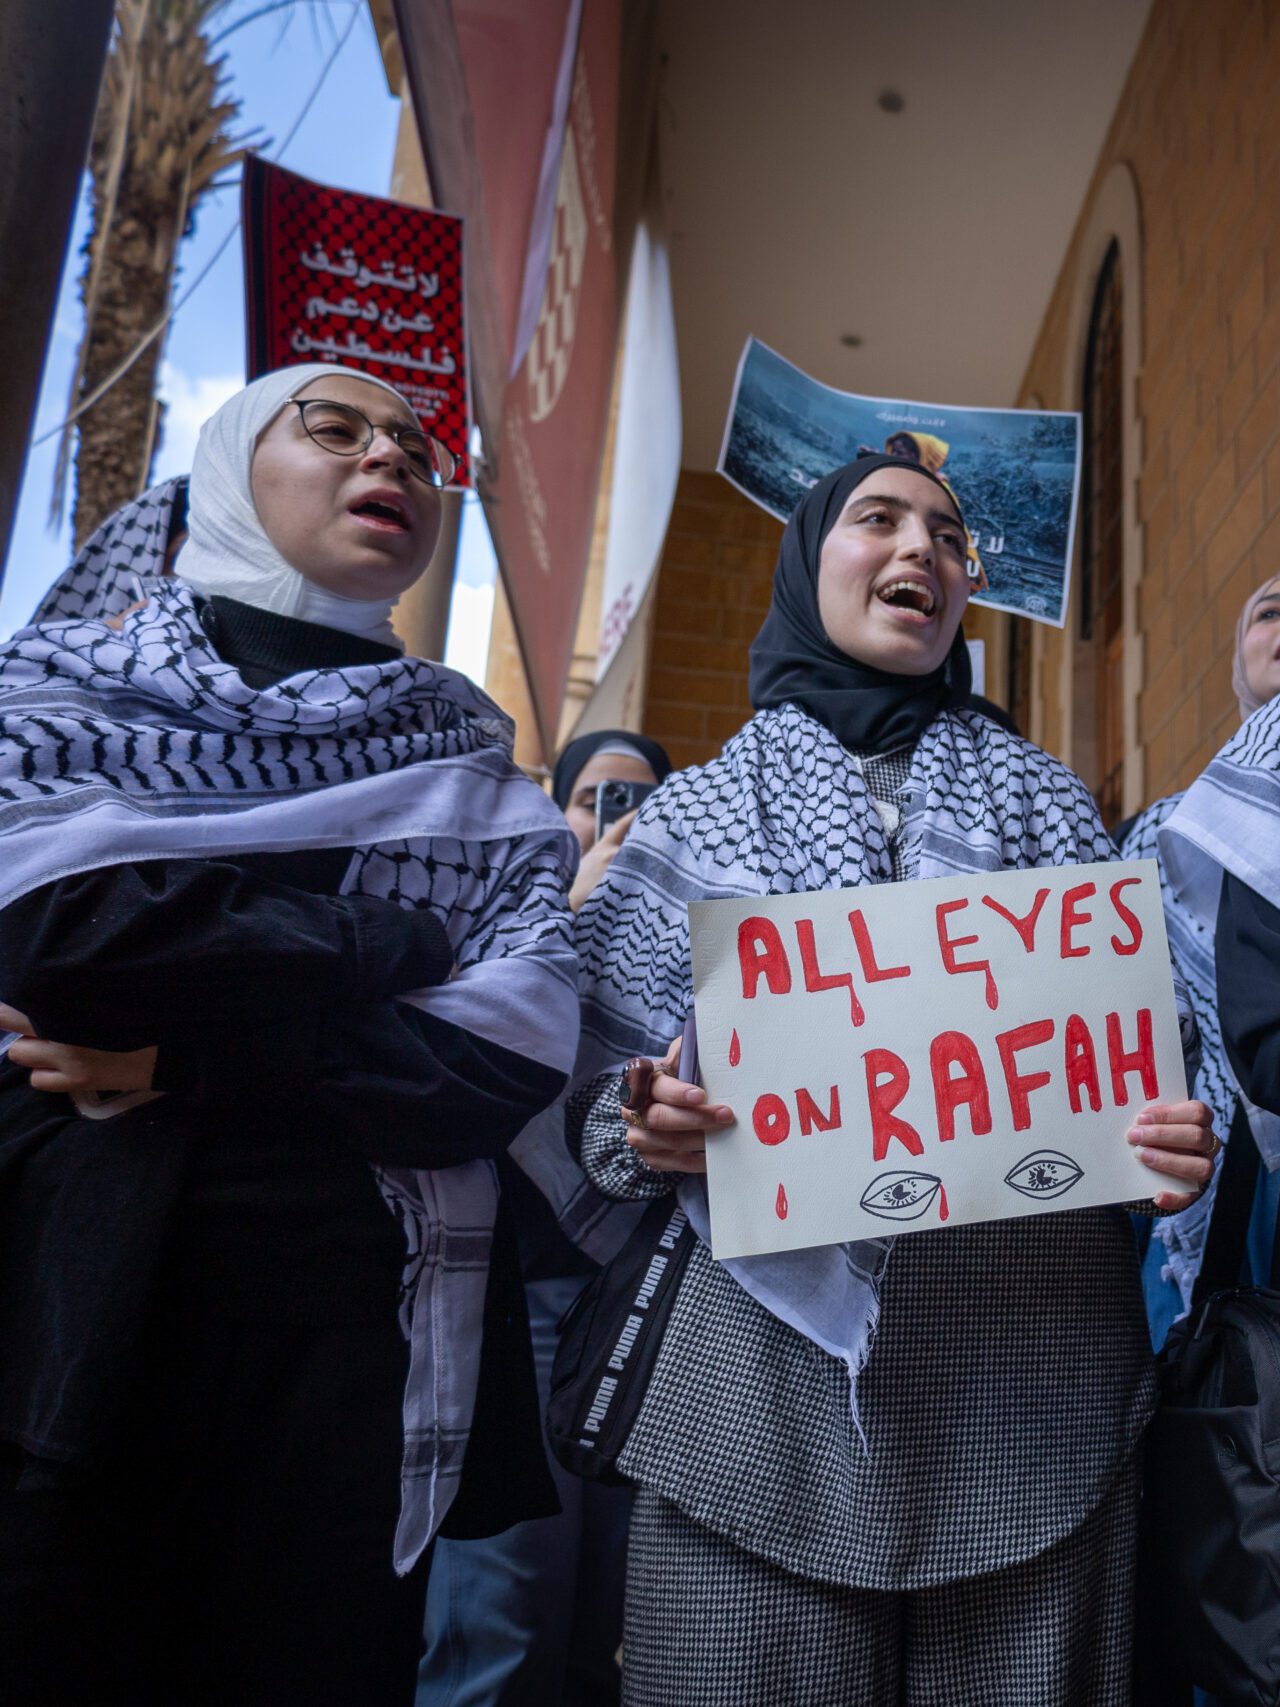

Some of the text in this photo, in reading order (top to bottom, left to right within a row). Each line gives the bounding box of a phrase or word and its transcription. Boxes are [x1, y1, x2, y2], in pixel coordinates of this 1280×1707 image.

[301, 242, 439, 297] لا تتوقف
[306, 297, 434, 332] عن دعم
[291, 328, 456, 375] فلسطين
[738, 877, 1143, 999] ALL EYES
[751, 1007, 1160, 1161] ON RAFAH
[659, 1207, 688, 1250] PUM
[634, 1254, 669, 1310] PUMA
[607, 1314, 644, 1371] PUMA
[584, 1376, 619, 1433] PUMA
